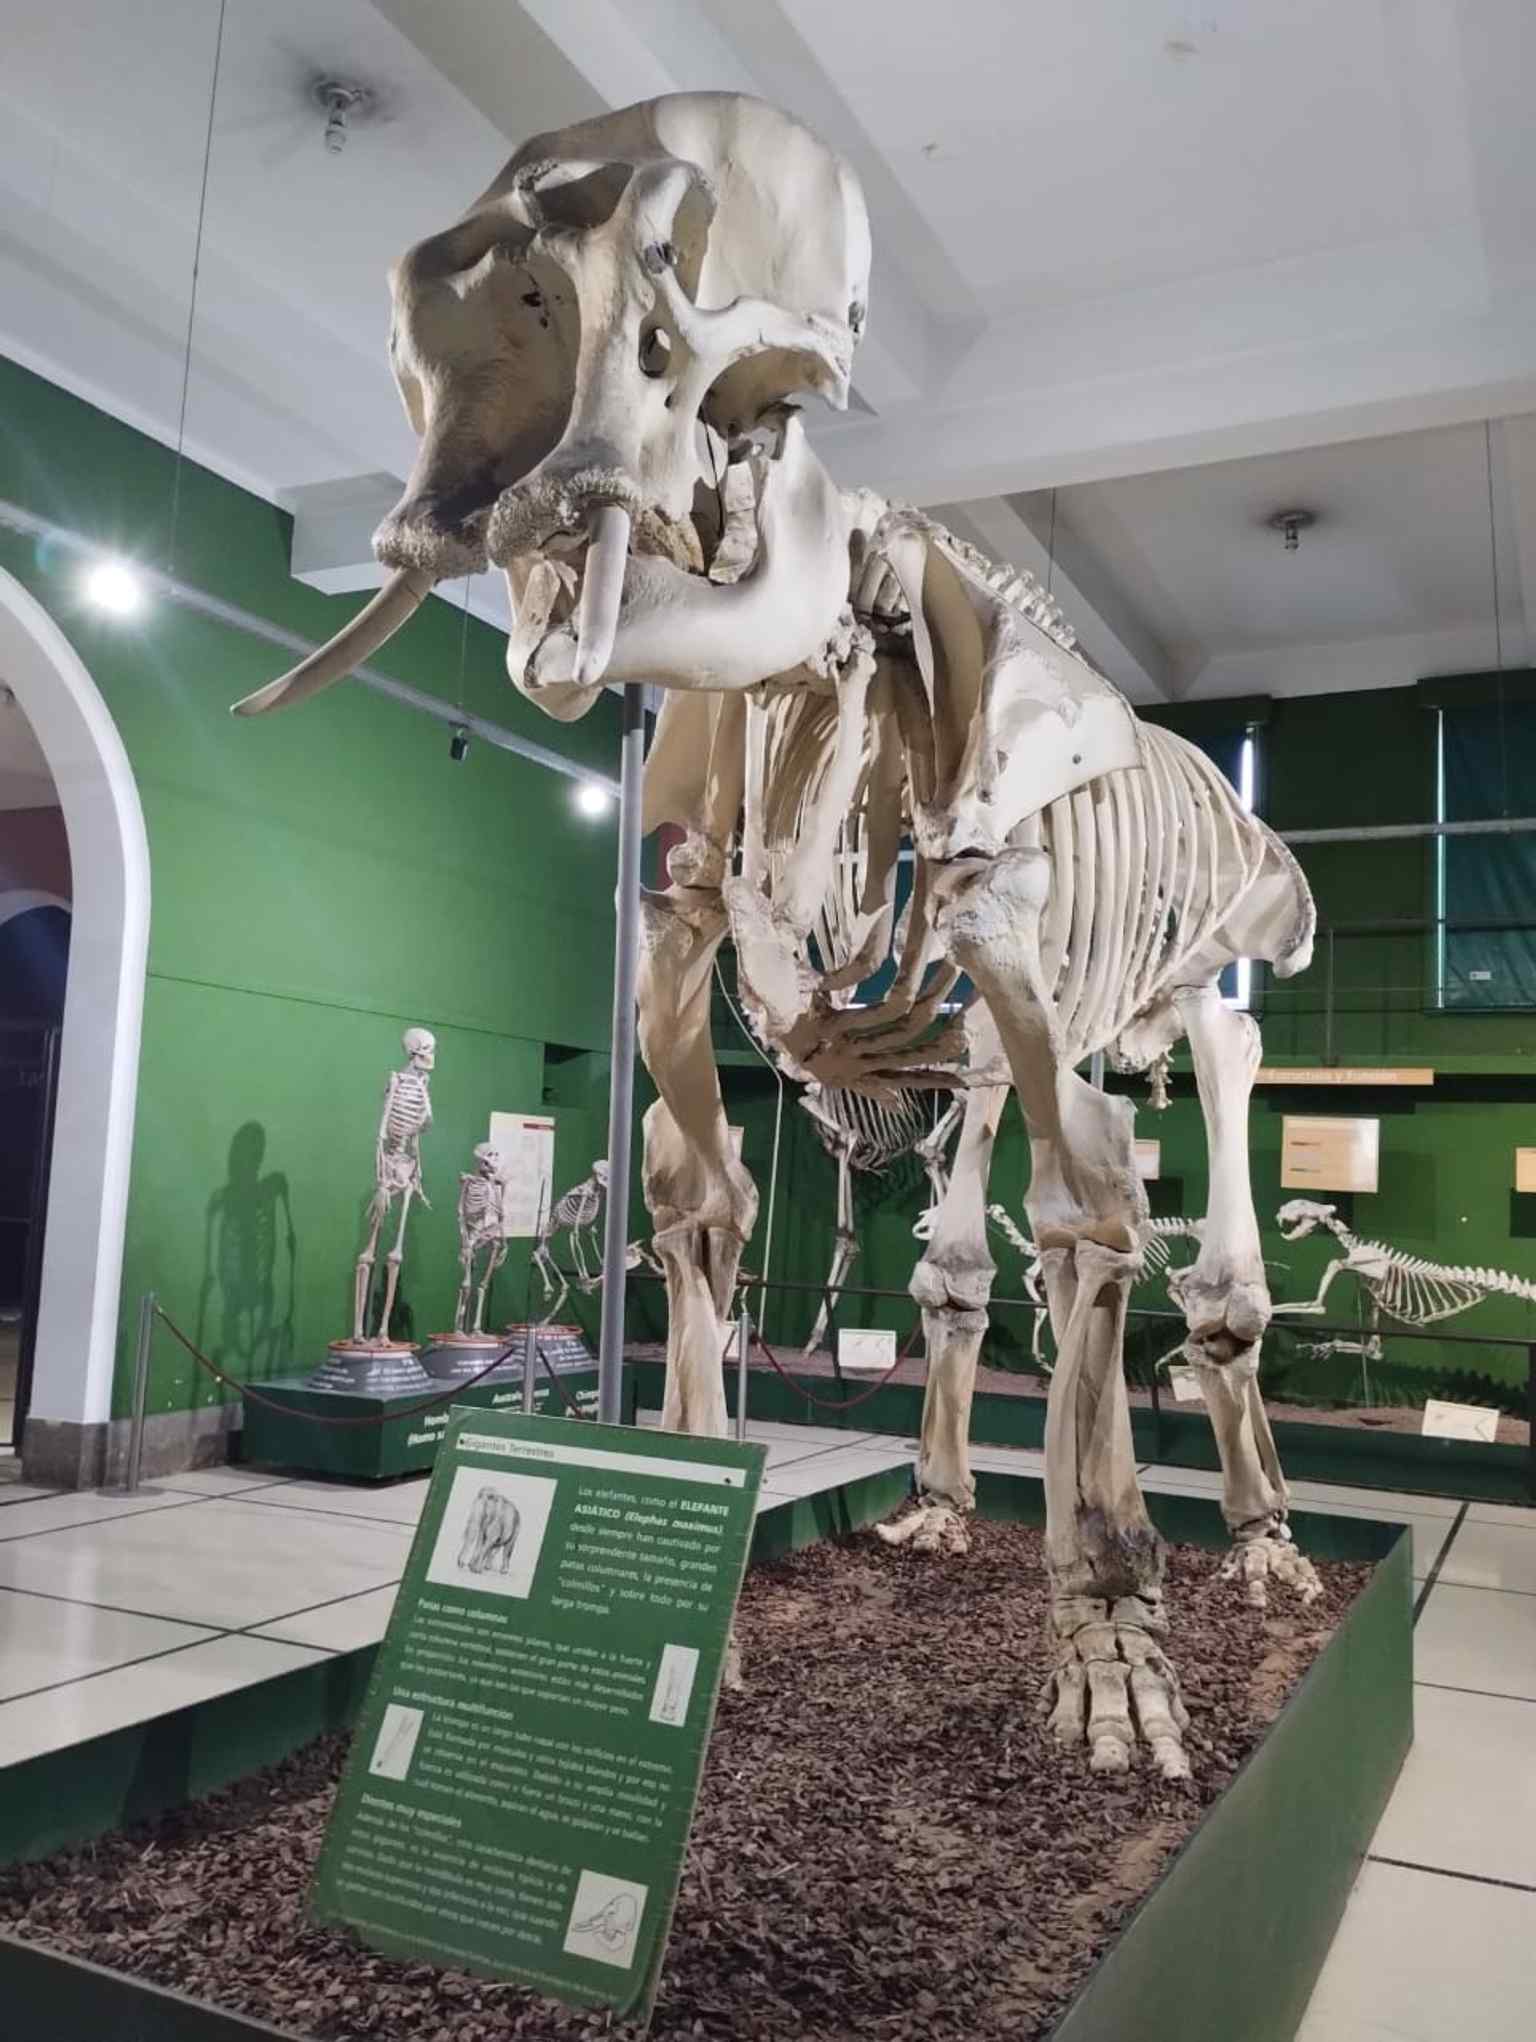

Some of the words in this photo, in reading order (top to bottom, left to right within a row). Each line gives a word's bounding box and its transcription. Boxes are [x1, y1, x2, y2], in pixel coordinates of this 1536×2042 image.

[577, 1486, 593, 1496] Los
[679, 1499, 729, 1516] ELEFANTE
[573, 1502, 622, 1519] ASIÁTICO
[622, 1510, 669, 1528] (Elephas
[635, 1532, 655, 1543] han
[703, 1543, 721, 1555] por
[678, 1559, 718, 1575] grandes
[618, 1587, 646, 1601] sobre
[674, 1597, 693, 1610] por
